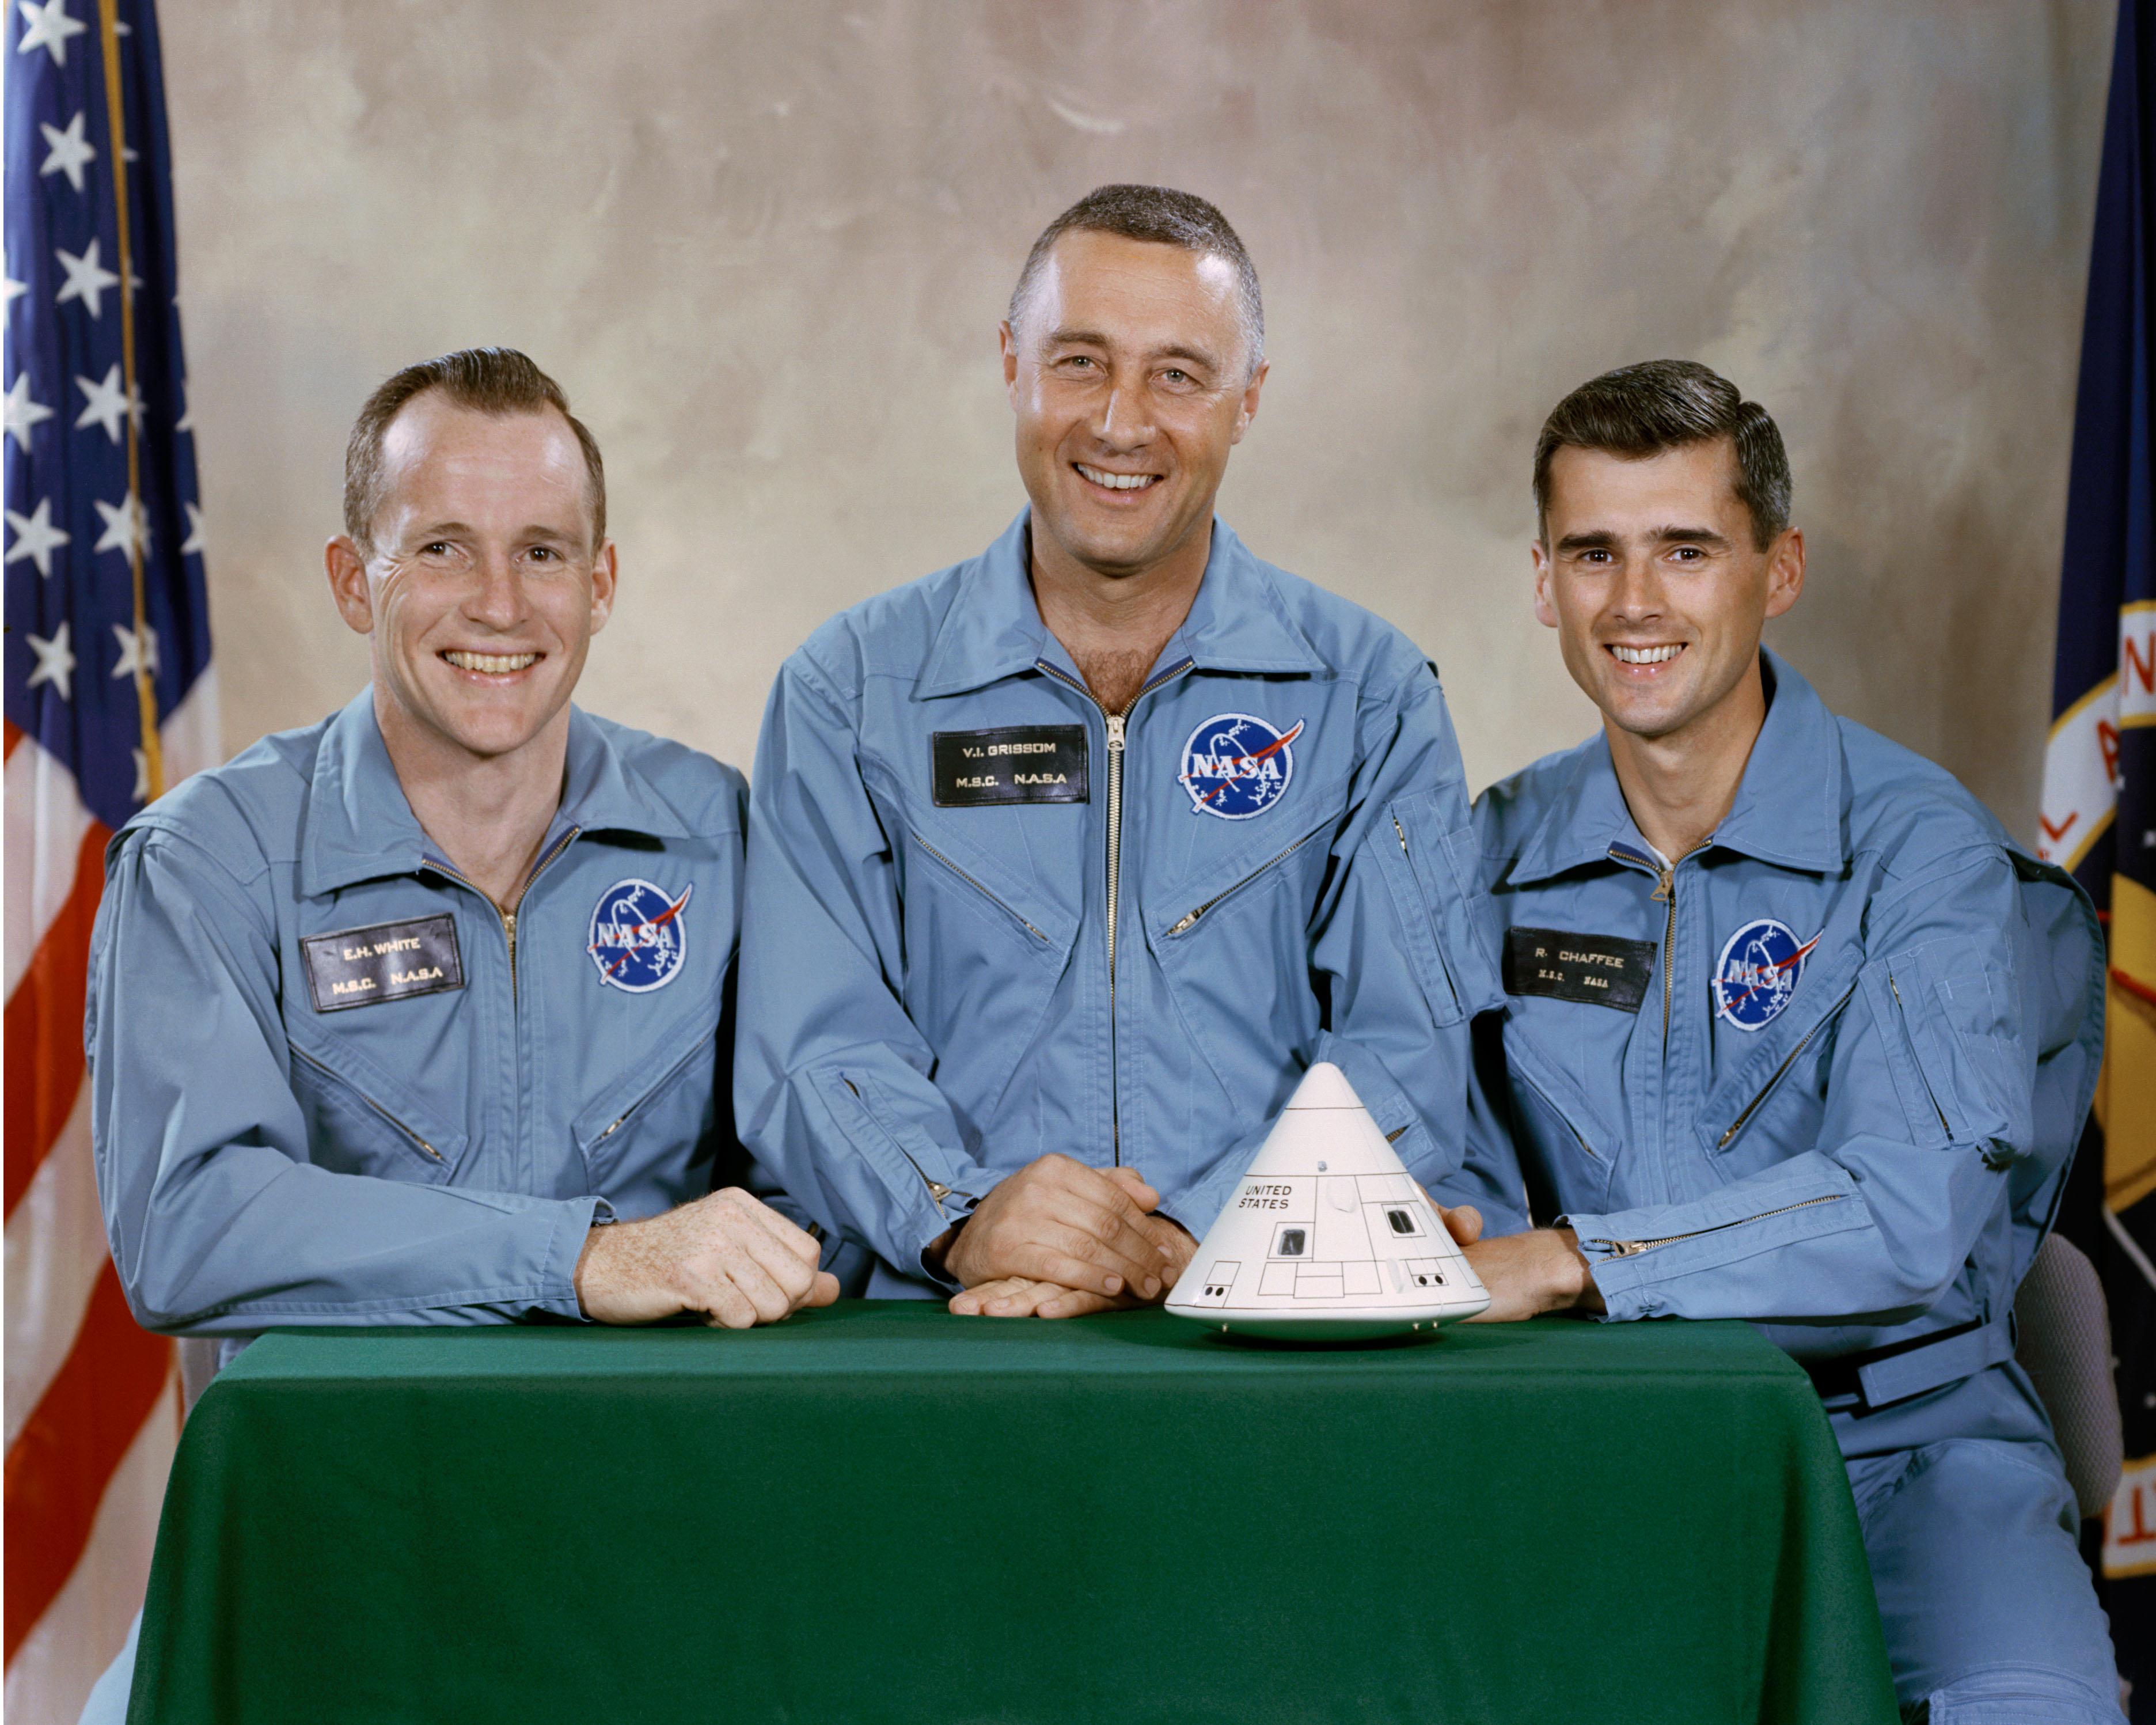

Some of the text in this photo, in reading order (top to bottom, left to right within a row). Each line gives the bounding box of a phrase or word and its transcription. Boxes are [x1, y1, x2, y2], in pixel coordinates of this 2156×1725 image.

[962, 743, 1056, 758] V.I. GRISSOM
[1190, 753, 1282, 780] NASA
[956, 773, 1068, 788] M.S.C. N.A.S.A
[597, 922, 677, 949] NASA
[343, 937, 421, 961] E.H. WHITE
[1535, 947, 1624, 968] R. CHAFFEE
[332, 966, 443, 995] M.S.C. N.A.S.A
[1538, 969, 1608, 988] M.S.C. NASA
[1725, 958, 1793, 991] NASA
[1245, 1185, 1292, 1196] UNITED
[1239, 1198, 1289, 1209] STATES
